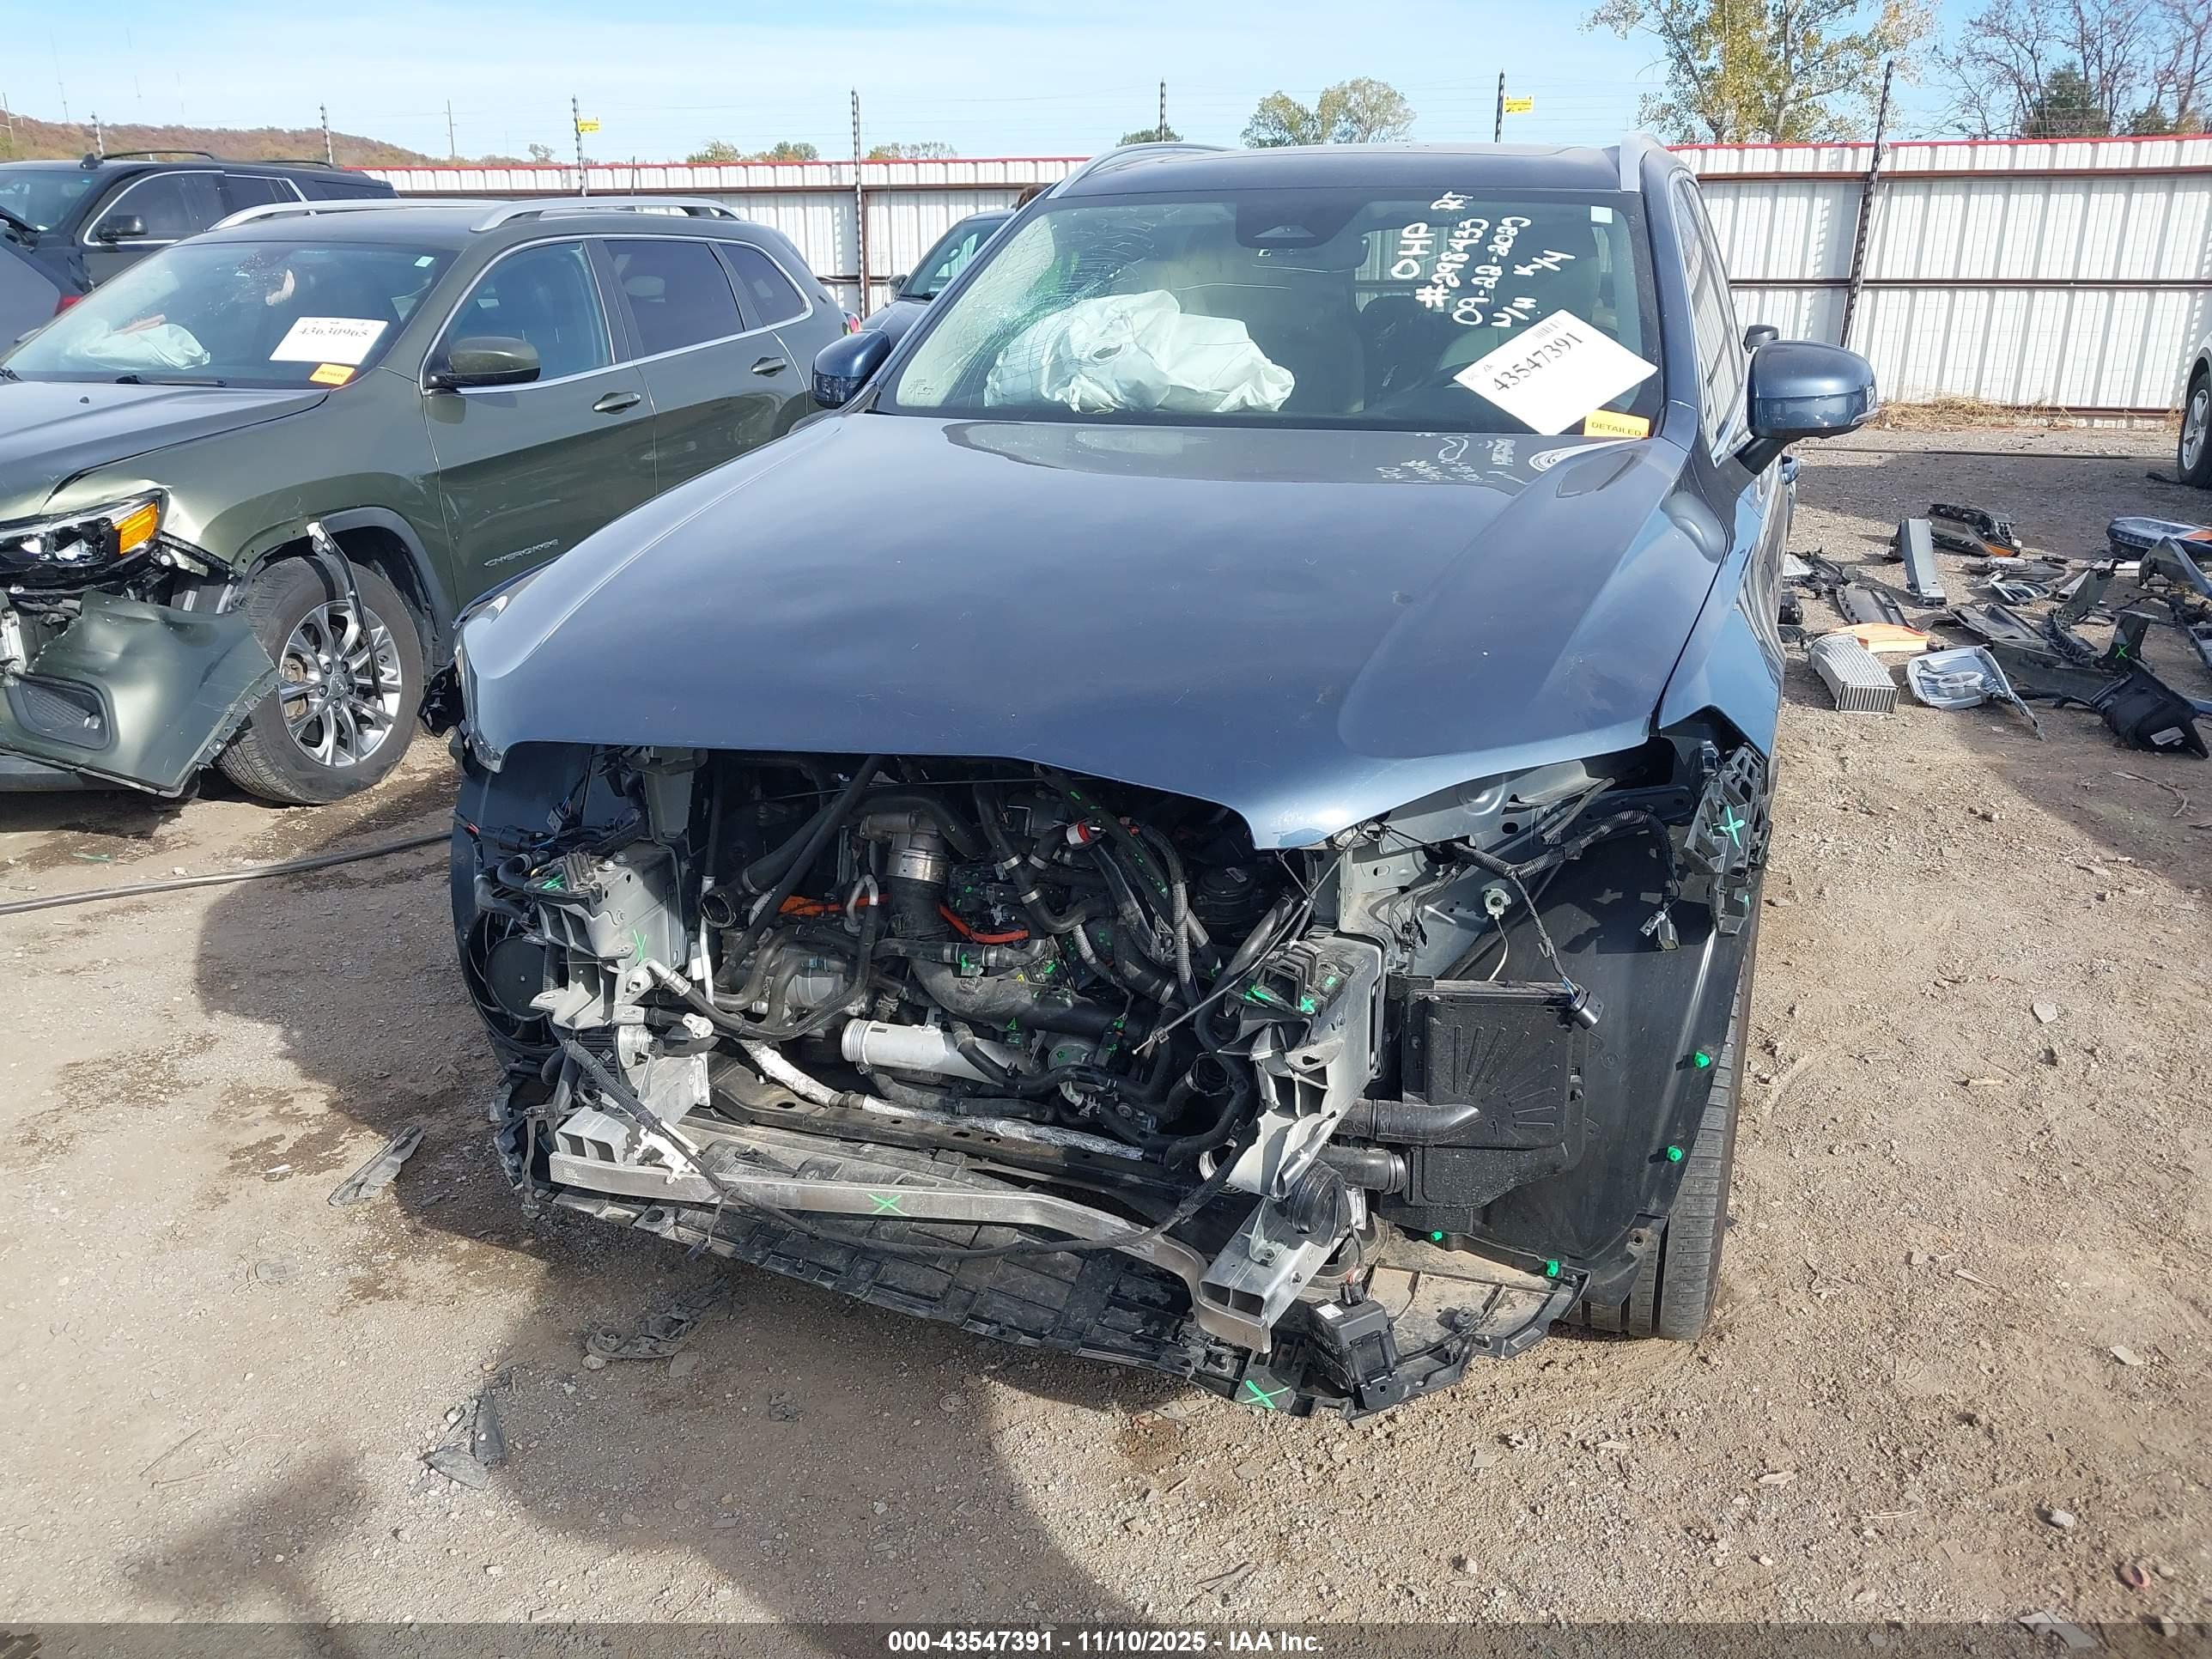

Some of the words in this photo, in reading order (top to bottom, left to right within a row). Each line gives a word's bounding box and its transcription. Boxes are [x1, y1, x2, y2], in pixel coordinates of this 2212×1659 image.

[1493, 331, 1583, 391] 43547391
[1591, 422, 1642, 436] DETAILED
[483, 538, 559, 567] CHEROKEE
